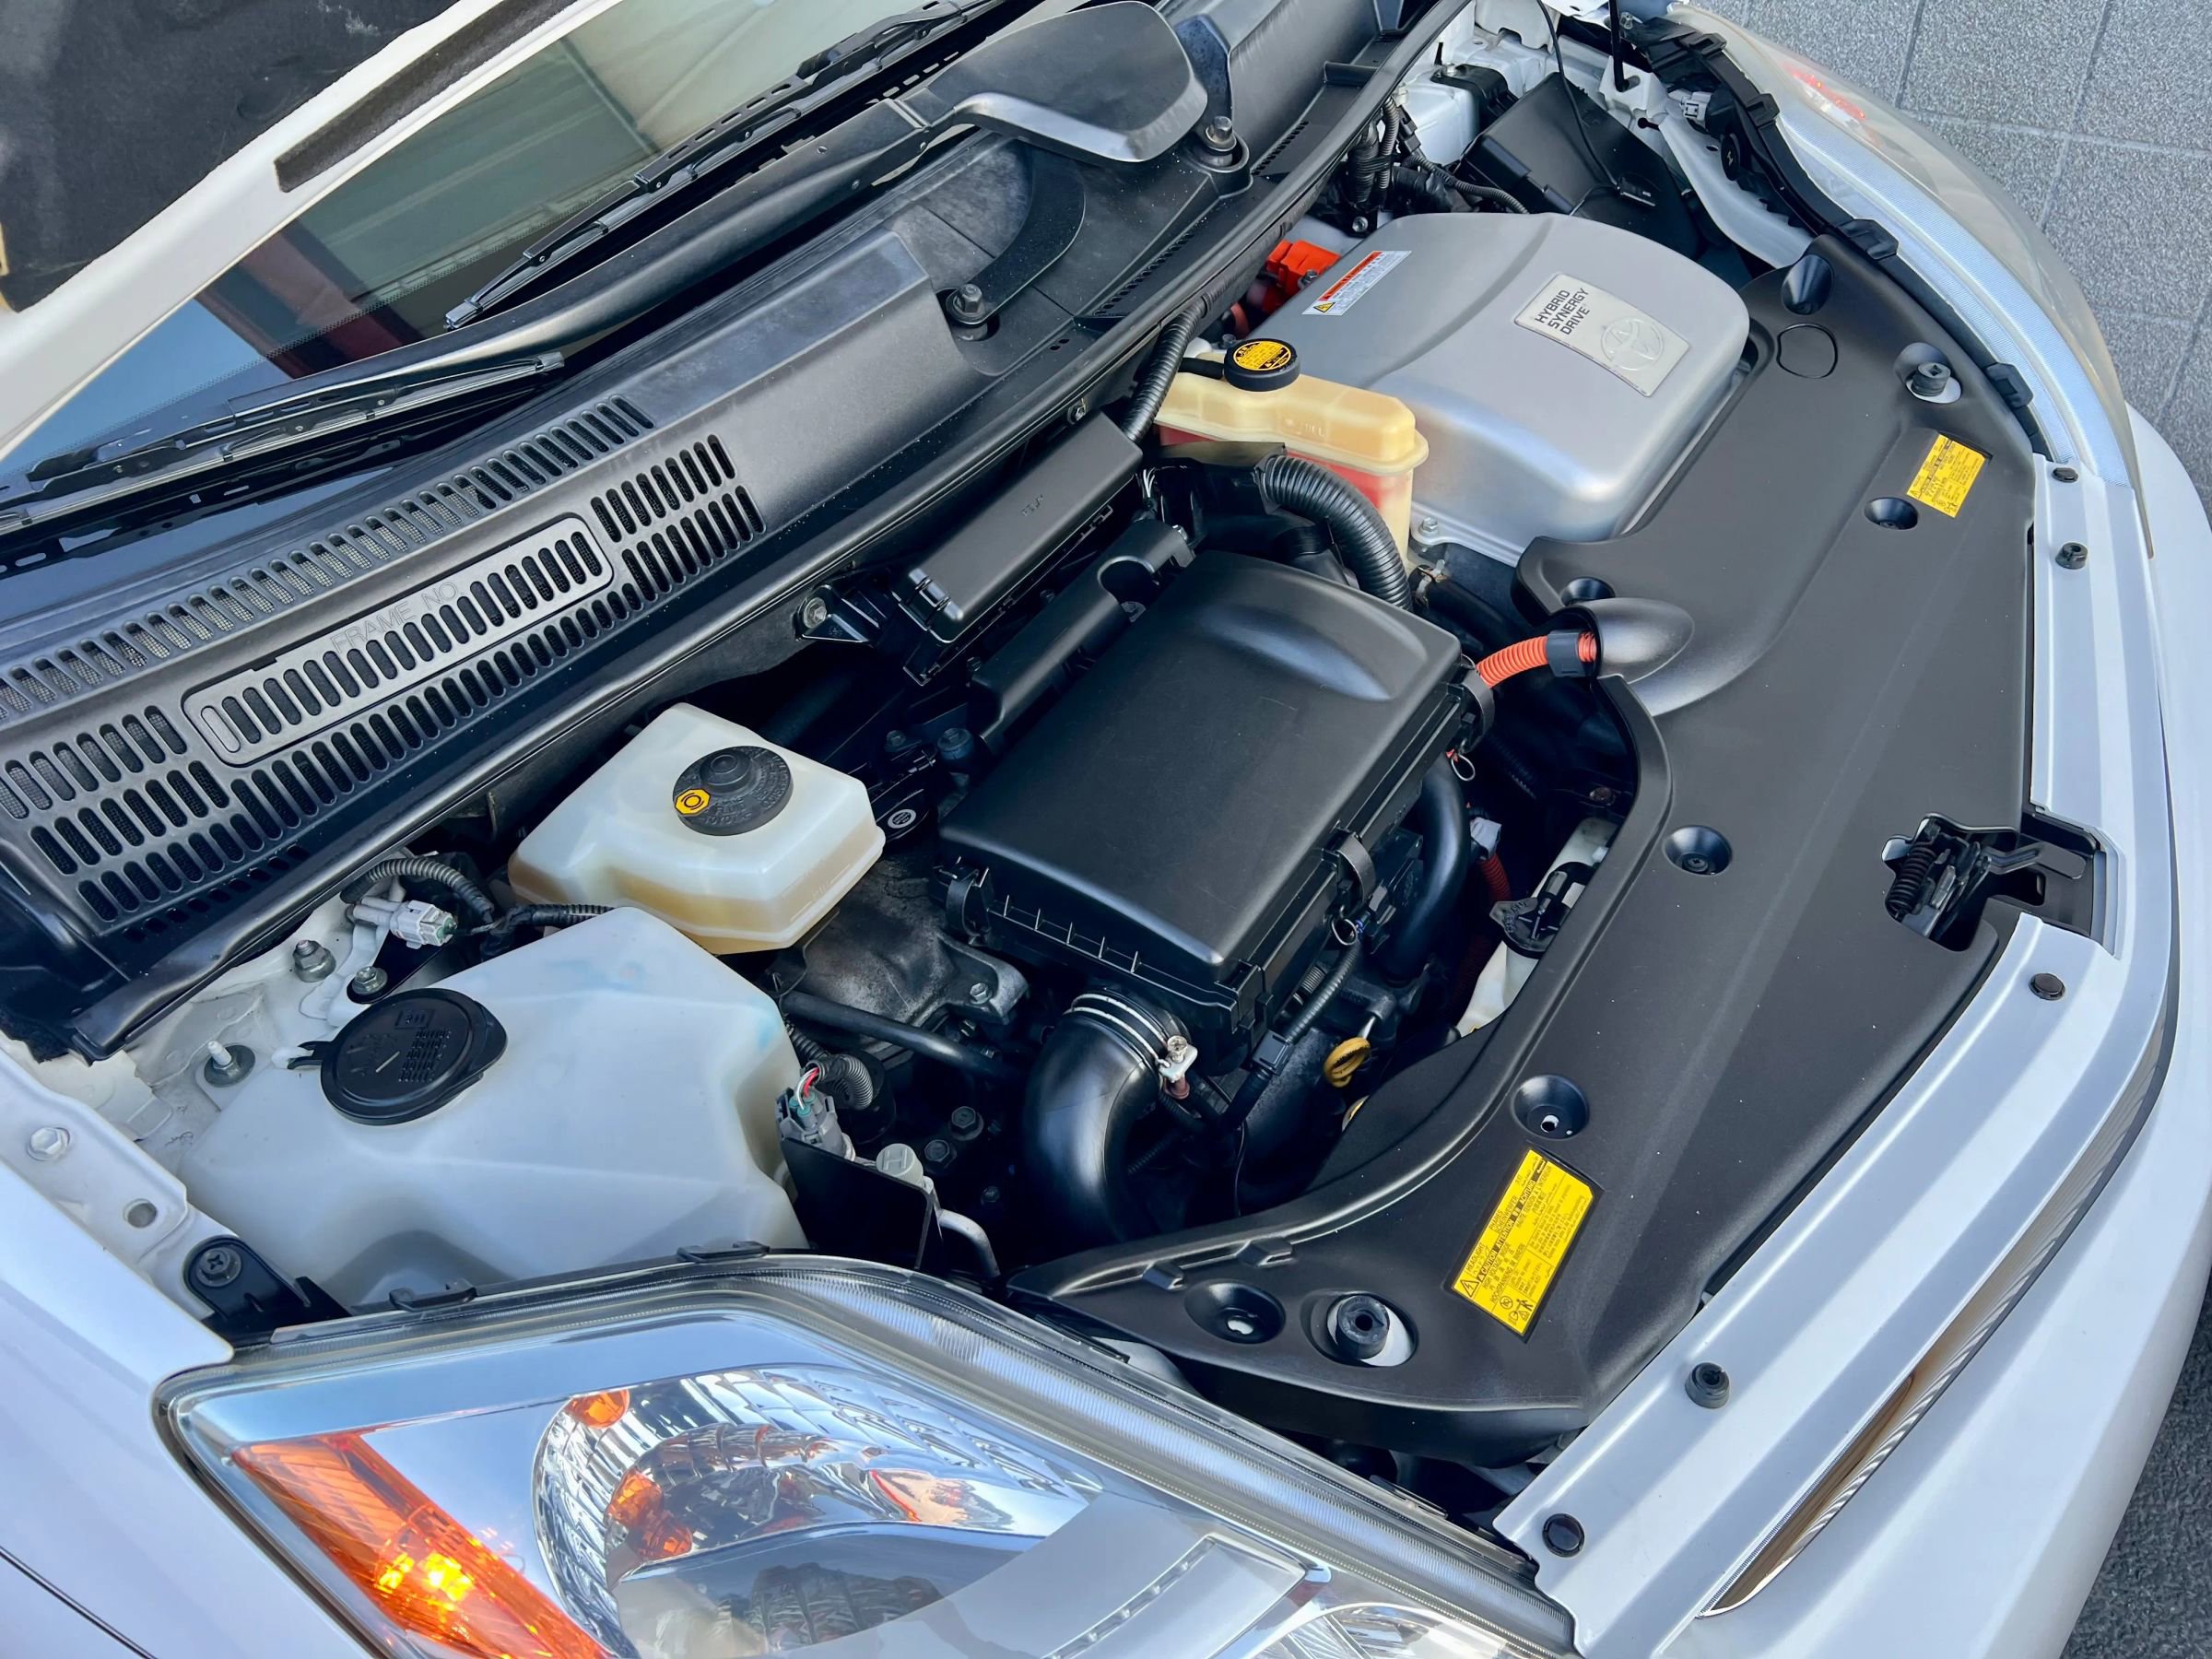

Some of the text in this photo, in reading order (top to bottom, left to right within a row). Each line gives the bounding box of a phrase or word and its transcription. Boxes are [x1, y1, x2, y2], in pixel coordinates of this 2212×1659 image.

[1535, 290, 1571, 324] HYBRID
[1547, 288, 1589, 329] SYNERGY
[1559, 306, 1590, 335] DRIVE
[330, 601, 416, 653] FRAME
[1480, 1249, 1497, 1274] CAUTION
[1495, 1218, 1514, 1247] ATTENTION
[1518, 1178, 1535, 1204] ACHTUNG
[1465, 1241, 1485, 1271] HEADLIGHT
